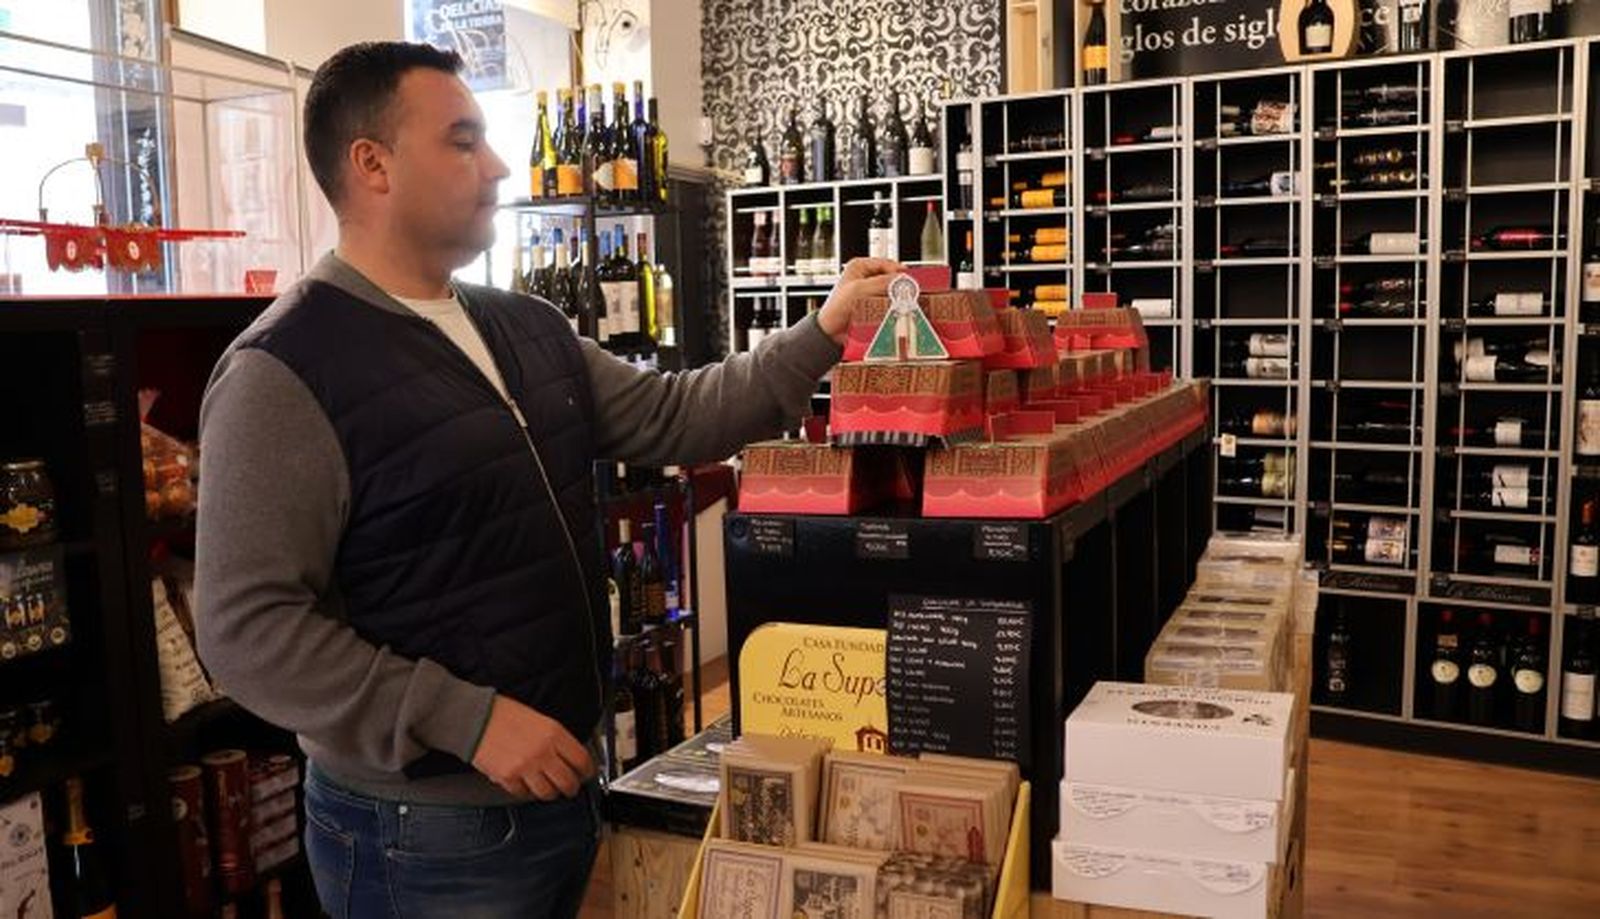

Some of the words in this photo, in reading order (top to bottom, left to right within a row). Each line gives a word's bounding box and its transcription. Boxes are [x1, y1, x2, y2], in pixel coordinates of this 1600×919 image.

[1181, 16, 1216, 46] de
[803, 636, 831, 650] CASA
[778, 647, 817, 691] La
[752, 691, 825, 708] CHOCOLATES
[781, 708, 844, 722] ARTESANOS
